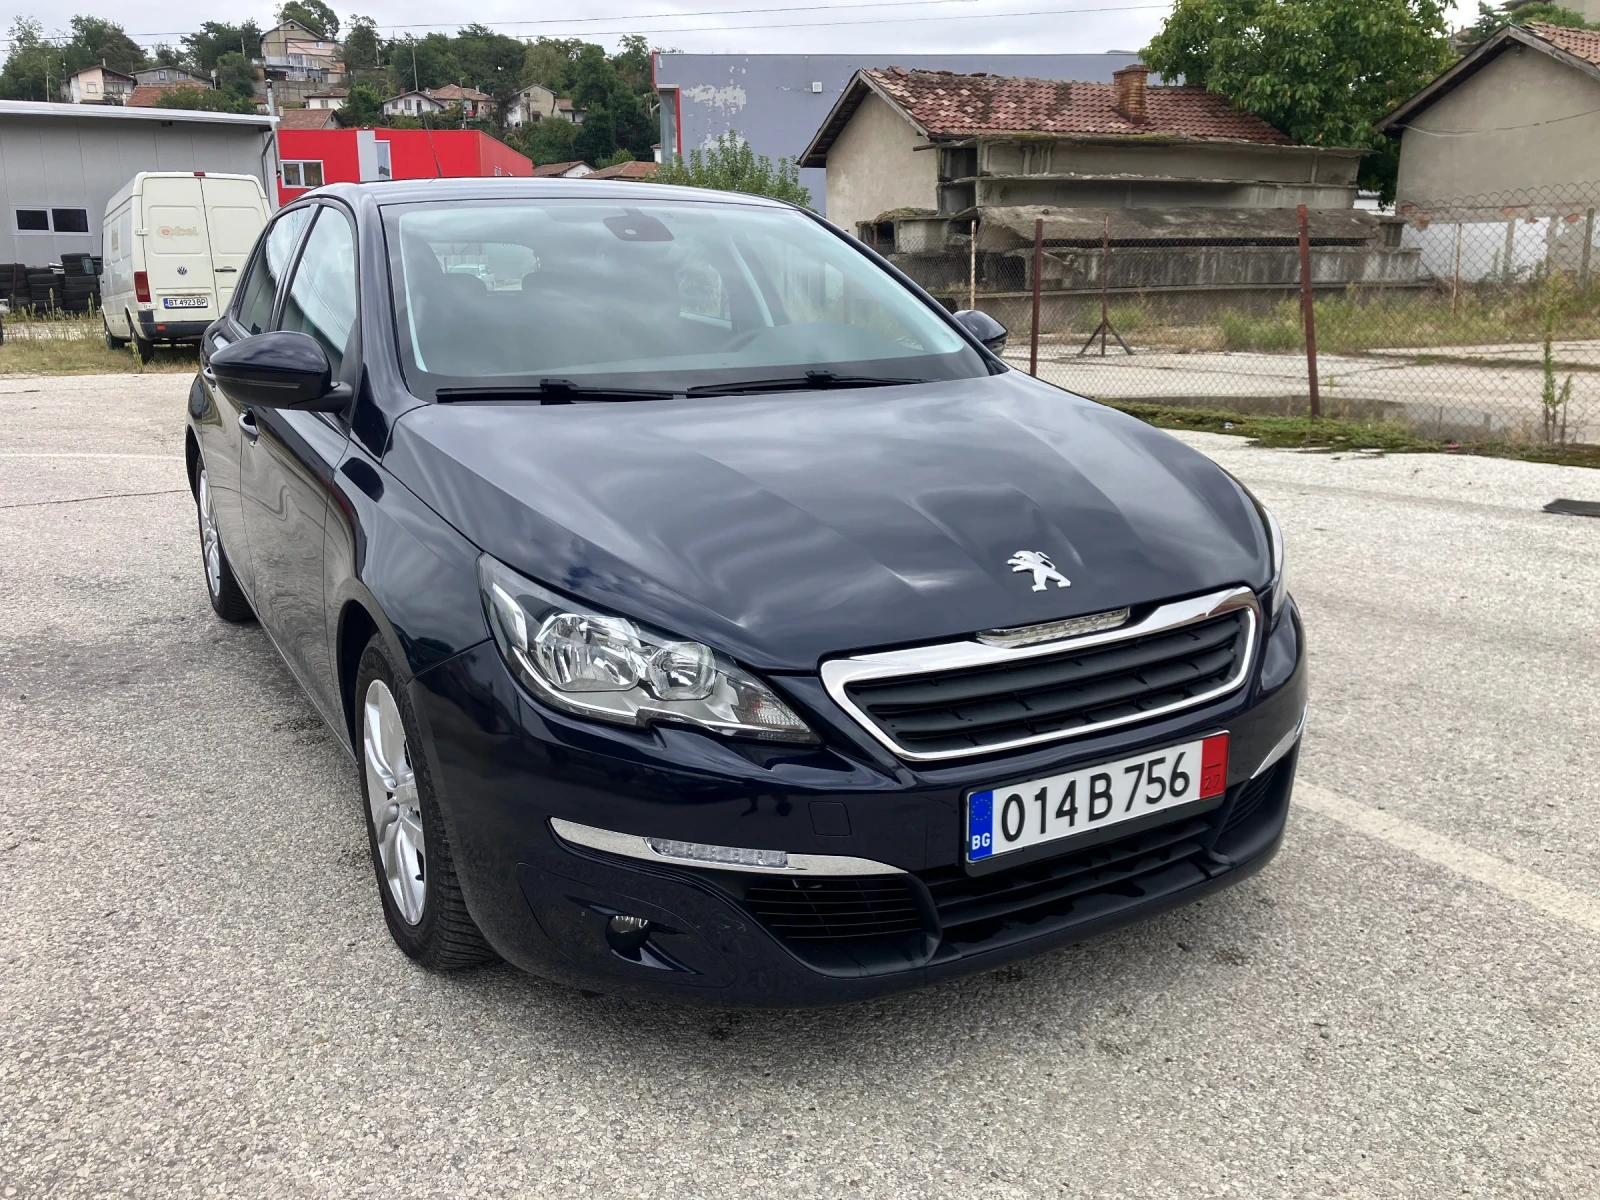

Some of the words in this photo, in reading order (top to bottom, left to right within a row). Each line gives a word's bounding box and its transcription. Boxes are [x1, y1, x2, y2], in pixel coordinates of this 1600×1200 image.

[1204, 773, 1221, 790] 27
[1001, 751, 1190, 842] 014B756
[972, 833, 991, 850] BG
